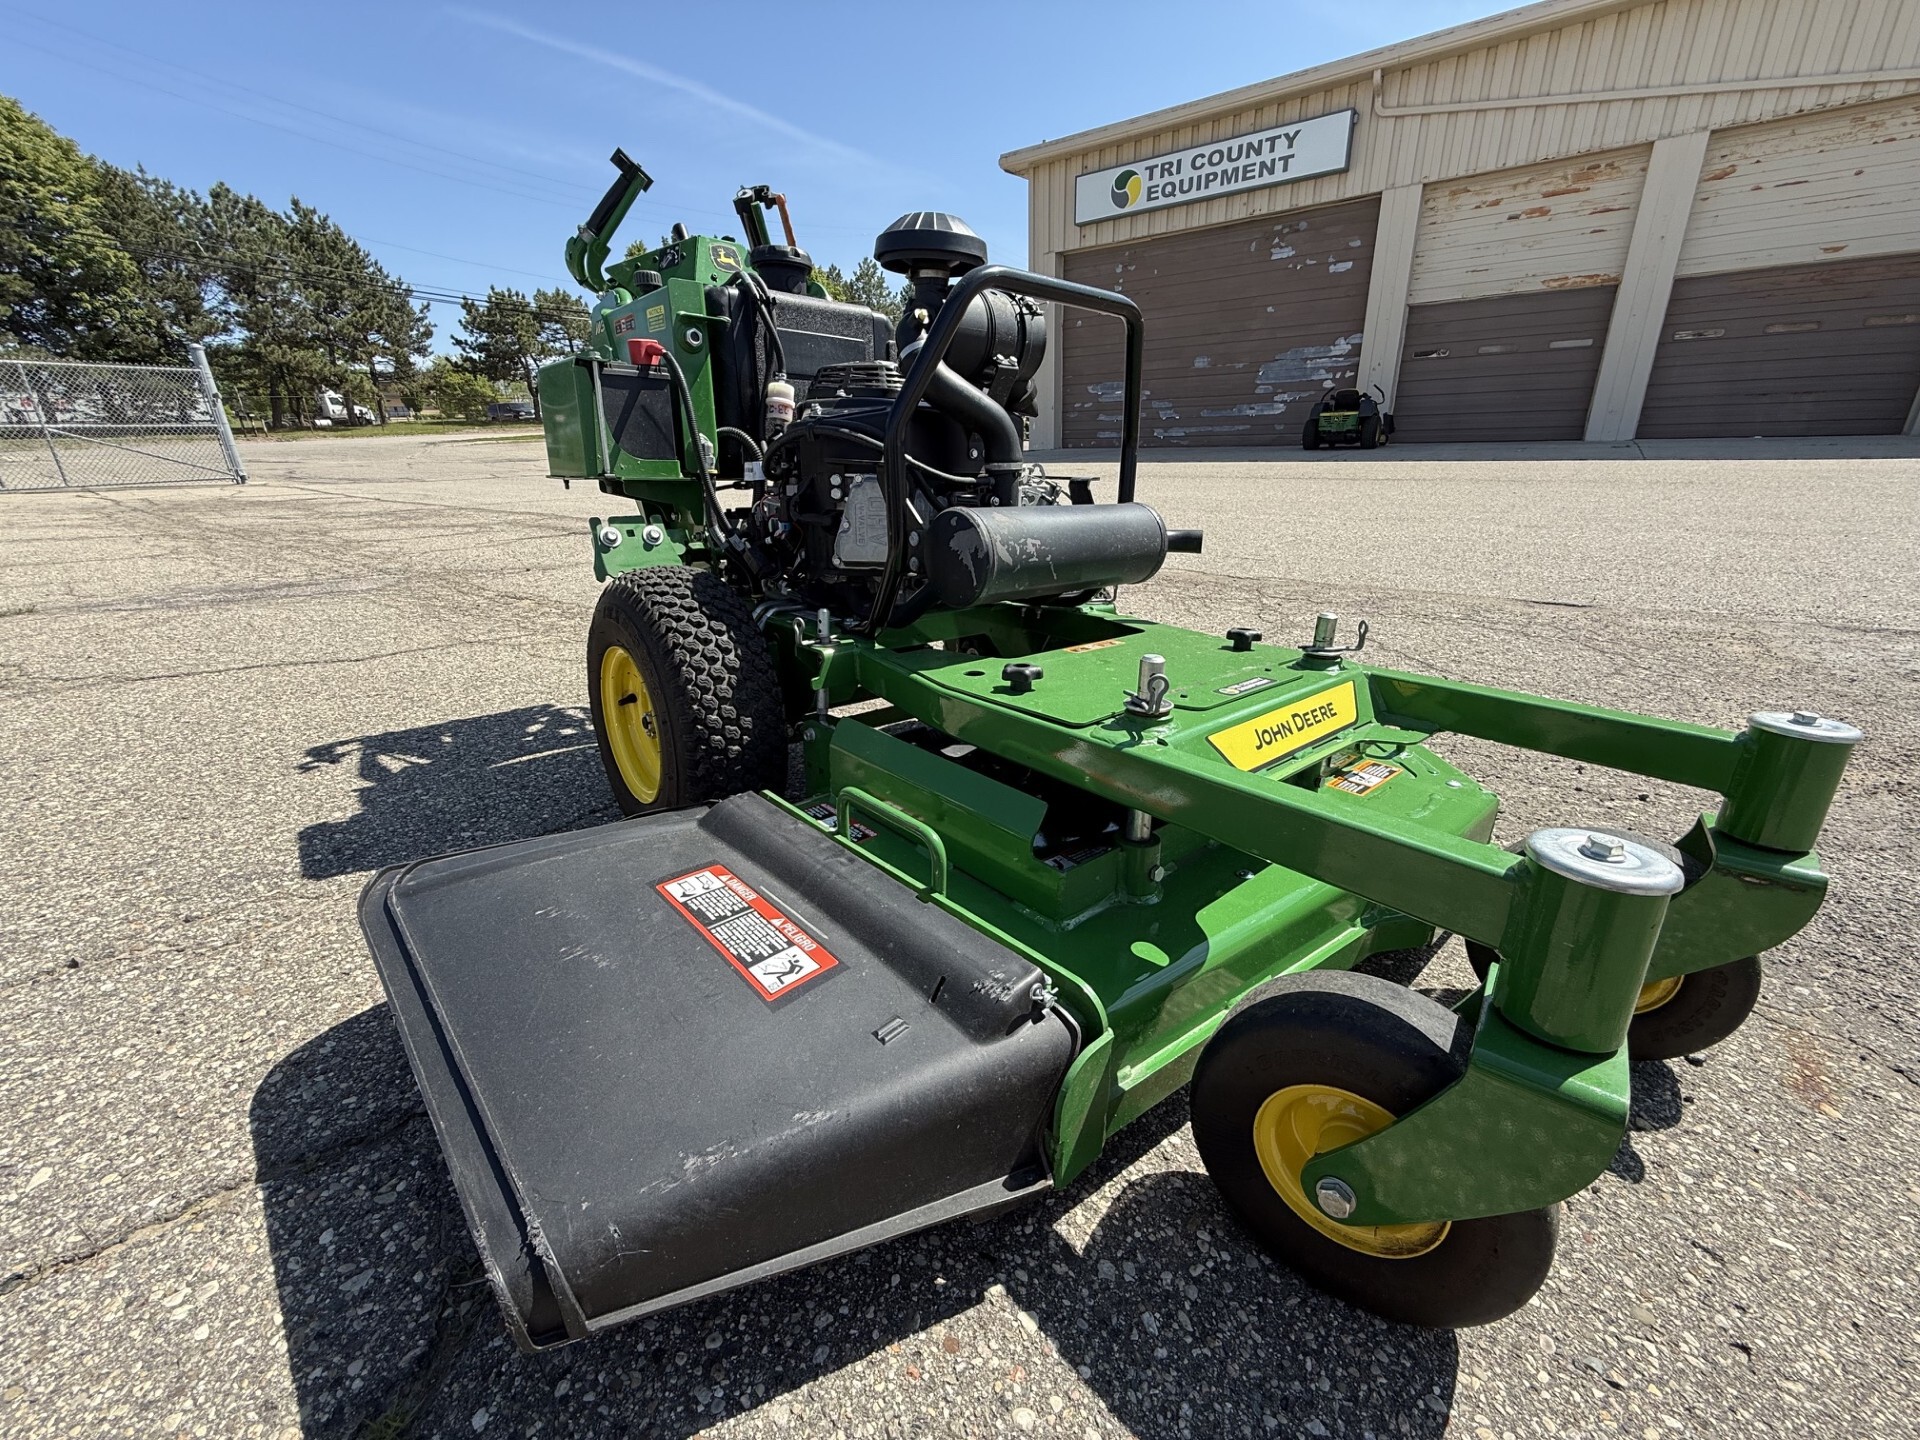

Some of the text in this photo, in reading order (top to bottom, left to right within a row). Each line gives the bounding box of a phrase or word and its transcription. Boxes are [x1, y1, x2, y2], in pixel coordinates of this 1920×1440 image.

[1145, 129, 1302, 181] TRI COUNTY
[1146, 154, 1295, 202] EQUIPMENT
[1254, 702, 1337, 750] JOHN DEERE
[726, 879, 757, 901] DANGER
[780, 922, 817, 952] PELIGRO
